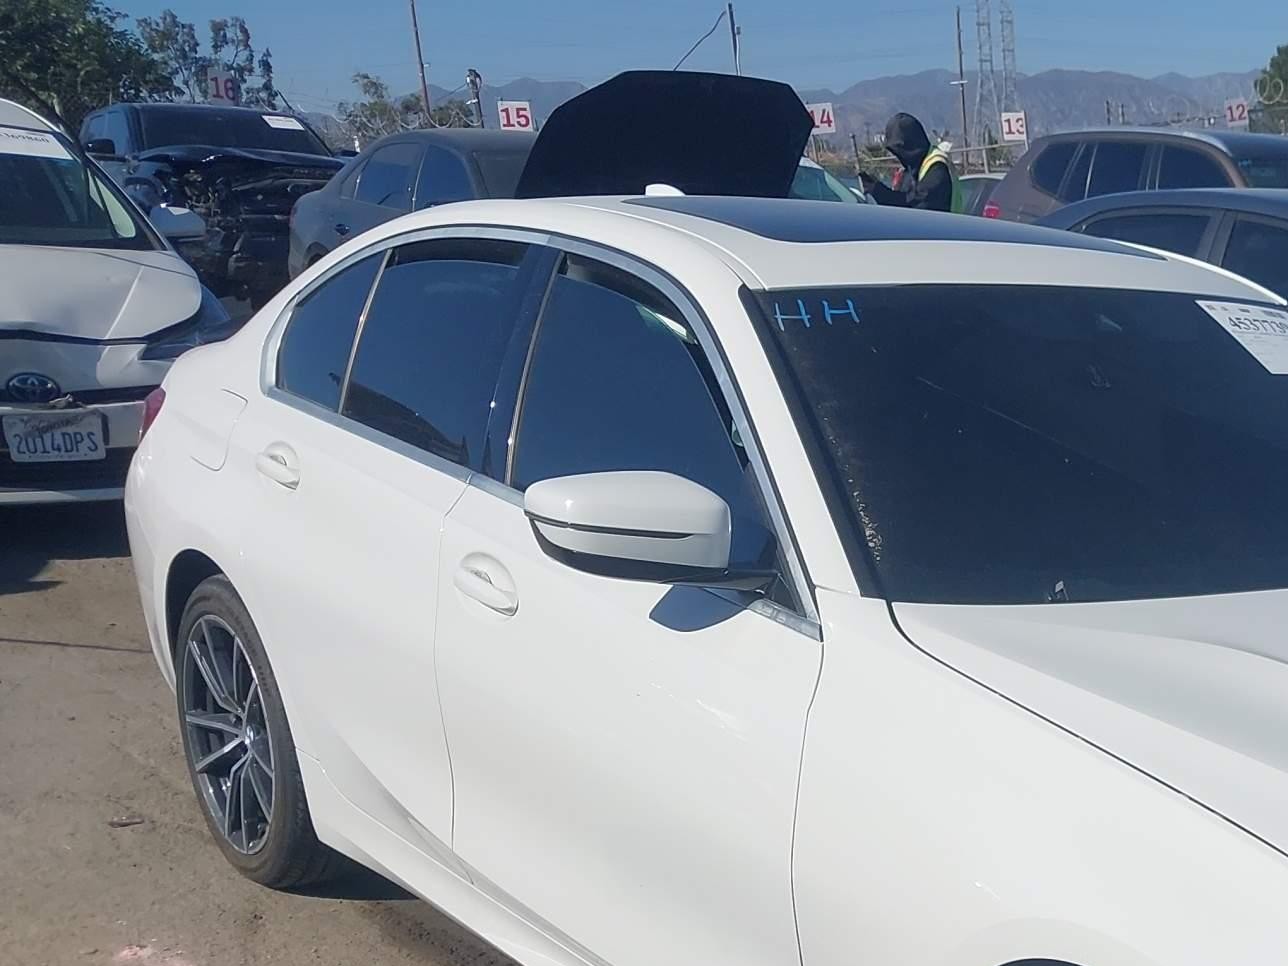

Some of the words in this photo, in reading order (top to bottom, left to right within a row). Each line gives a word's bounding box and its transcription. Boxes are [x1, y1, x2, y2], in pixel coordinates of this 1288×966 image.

[210, 76, 235, 100] 16
[500, 107, 530, 128] 15
[1226, 103, 1247, 122] 12
[1003, 117, 1024, 135] 13
